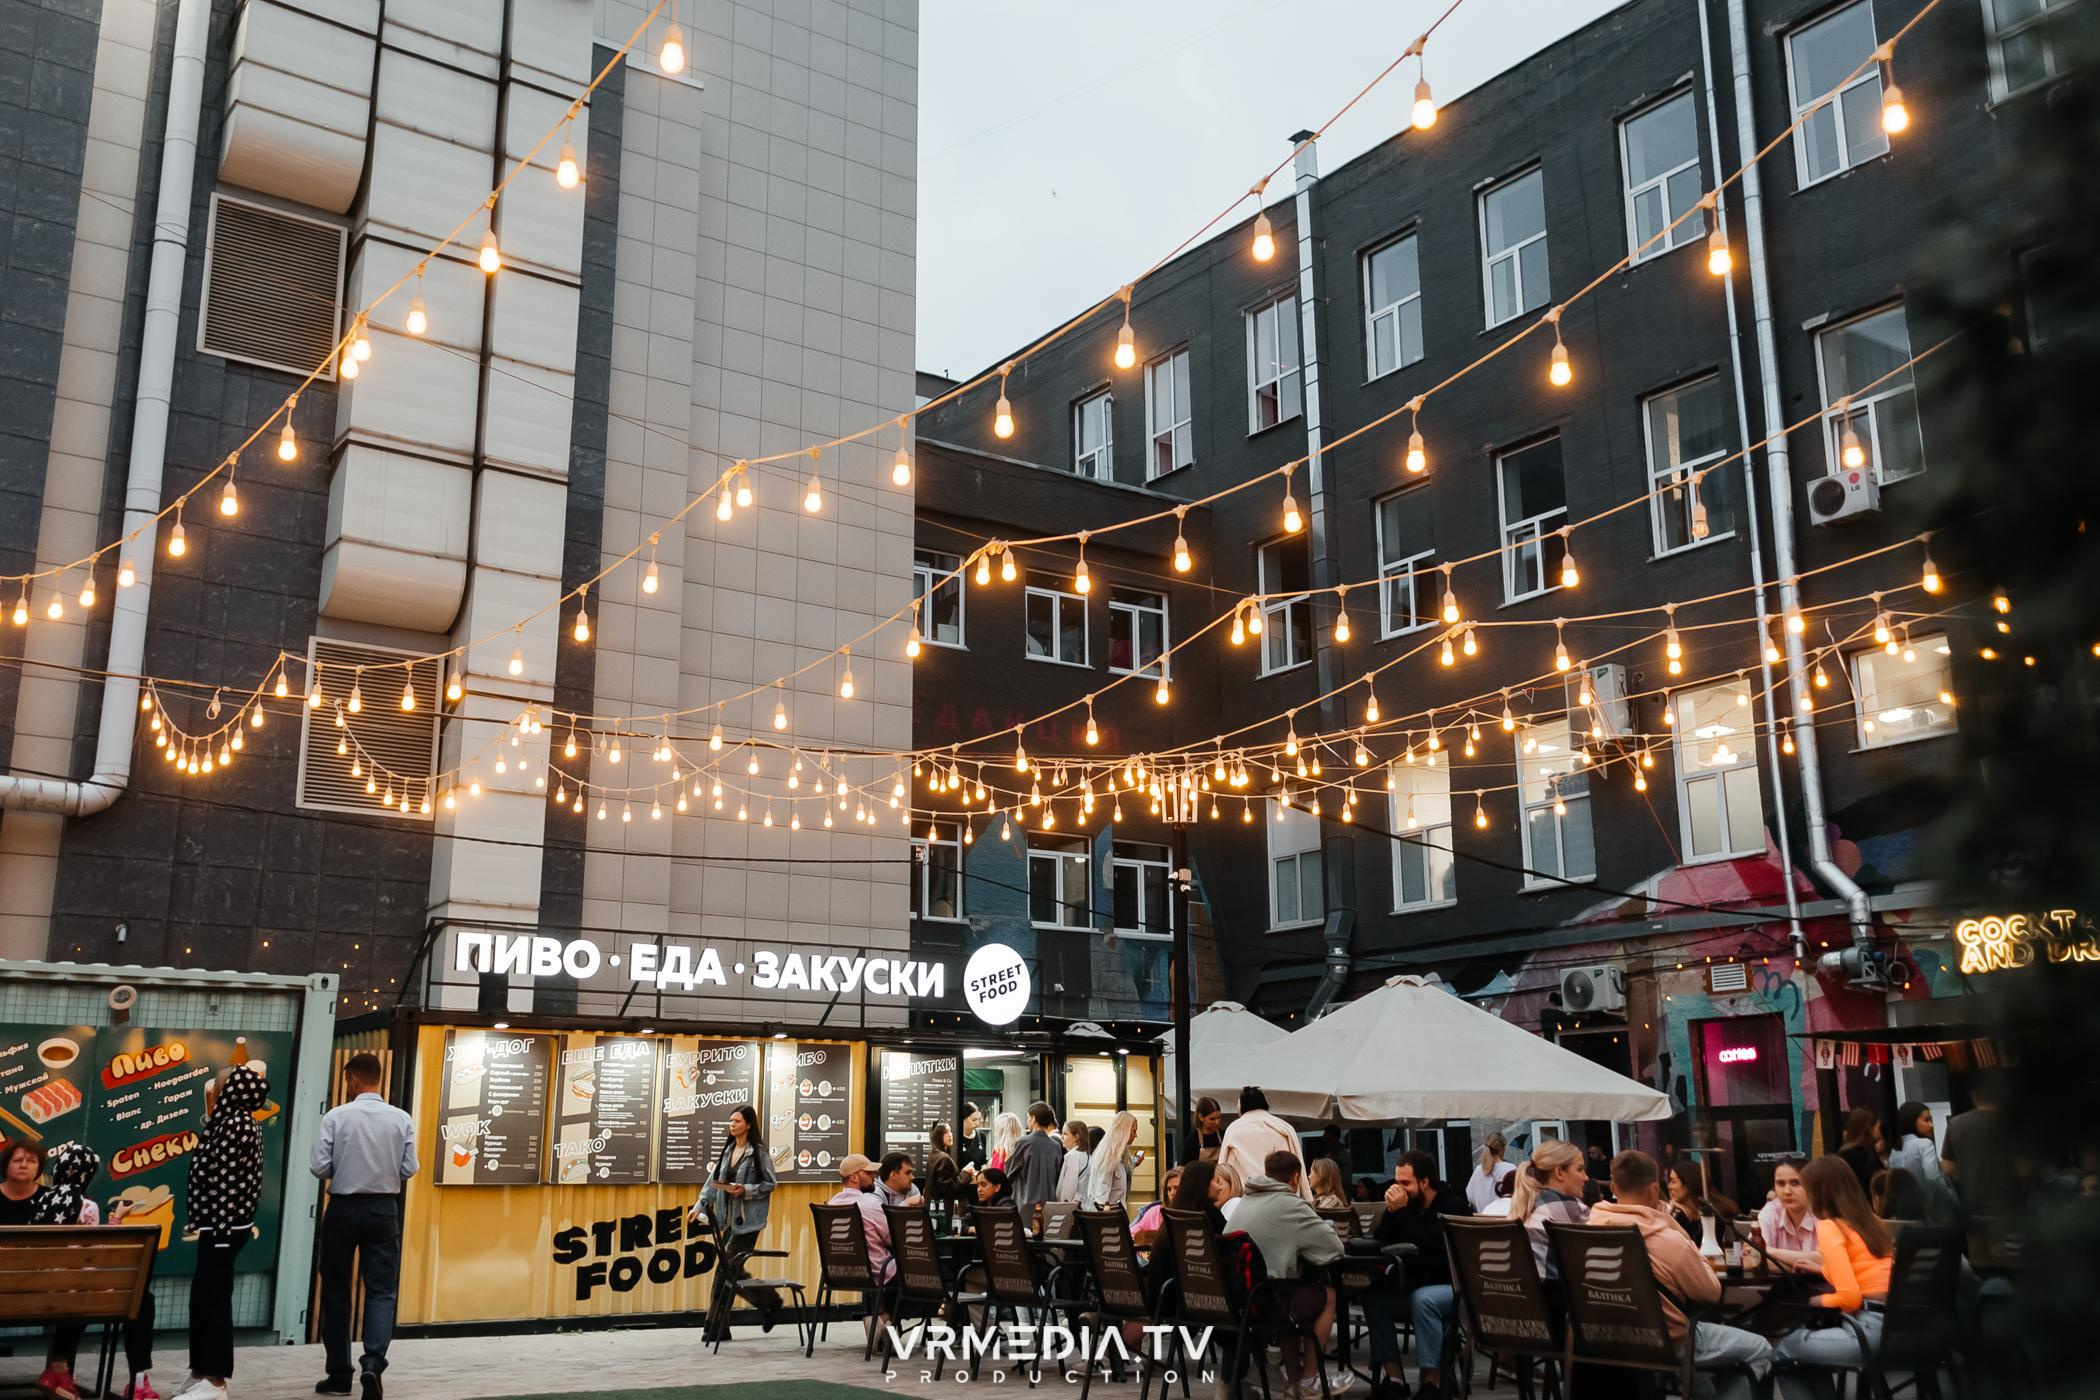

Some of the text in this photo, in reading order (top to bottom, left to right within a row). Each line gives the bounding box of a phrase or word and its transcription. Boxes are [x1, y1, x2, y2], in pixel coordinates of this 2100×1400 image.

[455, 932, 945, 998] ПИВО ЕДА ЗАКУСКИ
[971, 963, 1022, 992] STREET
[979, 980, 1018, 1004] FOOD
[111, 1043, 185, 1078] Пиво
[446, 1037, 535, 1062] ХТ-ДОГ
[610, 1041, 650, 1061] ЕДА
[666, 1045, 747, 1068] БУРРИТО
[767, 1050, 827, 1071] МБО
[153, 1066, 209, 1090] Hoegaarden
[883, 1057, 957, 1080] ПИТКИ
[5, 1072, 49, 1094] Мужской
[107, 1092, 139, 1108] Spaten
[163, 1089, 193, 1104] Гараж
[663, 1088, 749, 1113] ЗАКУСКИ
[116, 1108, 142, 1122] Blanc
[156, 1108, 190, 1124] Дизель
[441, 1120, 493, 1140] WOK
[112, 1132, 199, 1173] Снеки
[554, 1138, 606, 1158] ТАКО
[575, 1240, 718, 1301] FOOD
[1483, 1281, 1522, 1293] БАЛТИКА
[1587, 1289, 1632, 1304] БАЛТИКА
